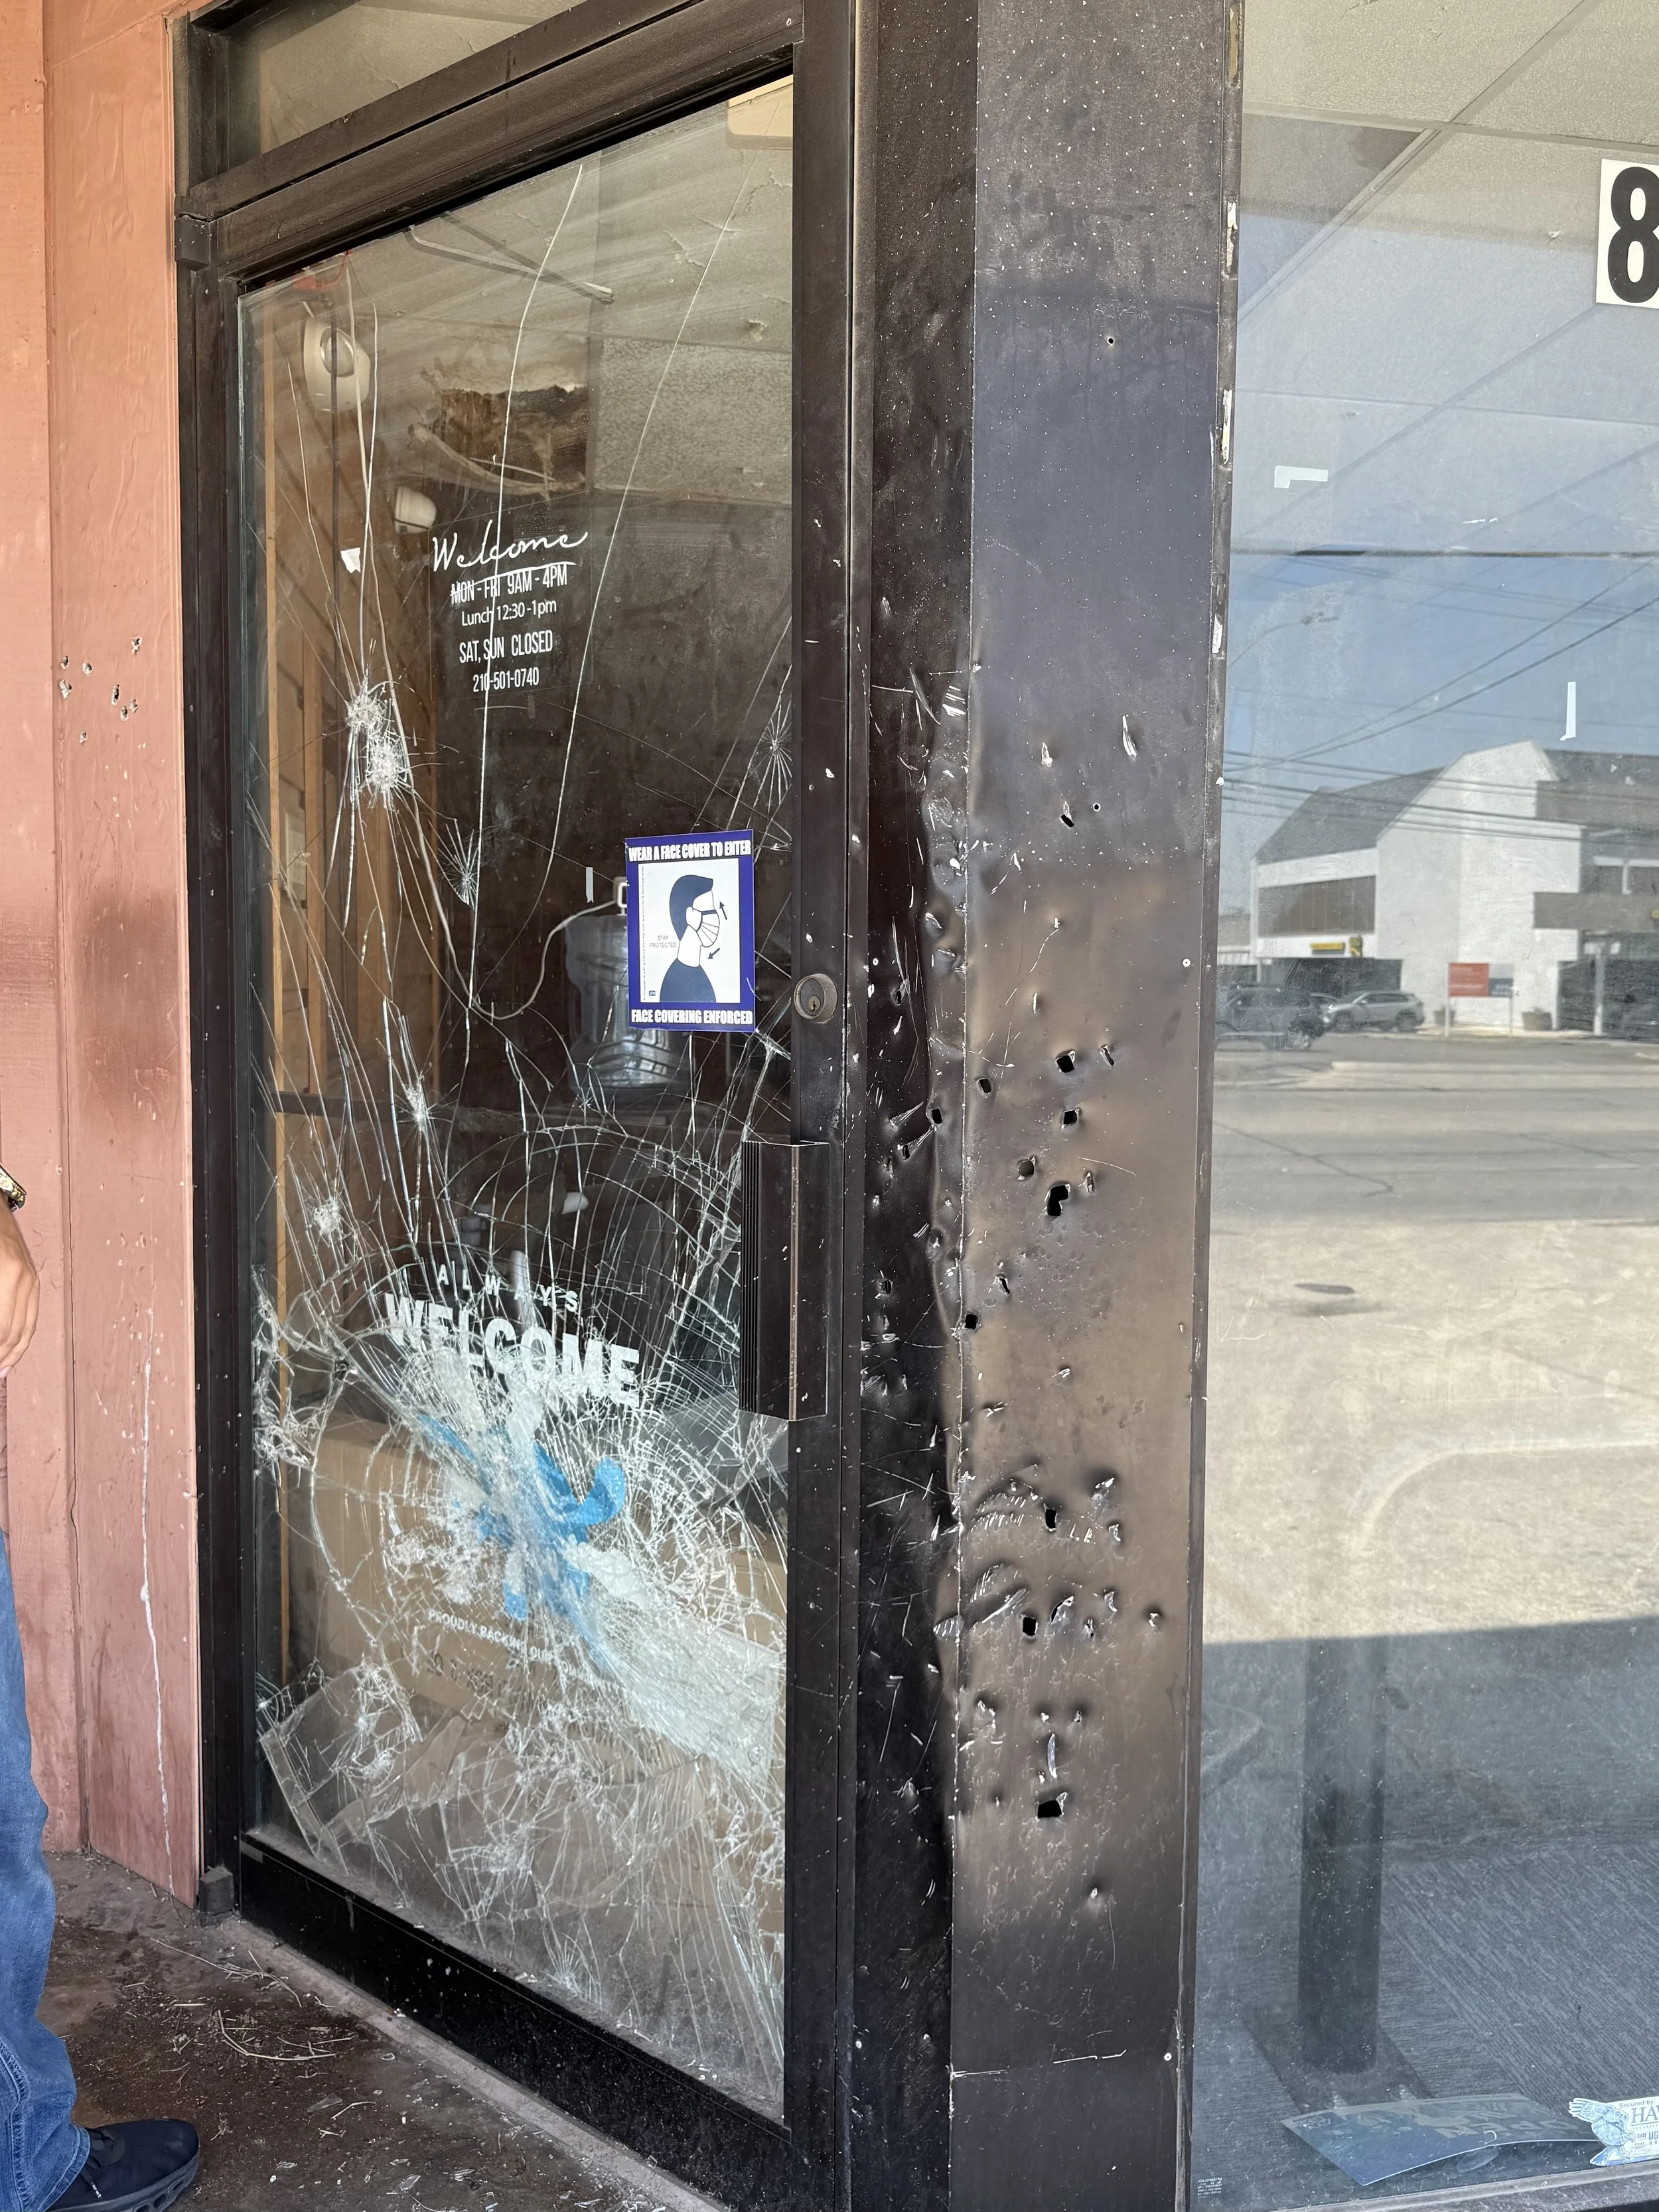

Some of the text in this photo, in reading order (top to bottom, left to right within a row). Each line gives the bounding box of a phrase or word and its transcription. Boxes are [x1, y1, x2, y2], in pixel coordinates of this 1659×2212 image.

[432, 519, 588, 572] Welcome
[451, 579, 474, 604] MON
[484, 577, 501, 599] FRI
[507, 570, 532, 595] 9AM
[542, 564, 567, 588] 4PM
[461, 606, 492, 626] Lunch
[511, 630, 553, 657] CLOSED
[472, 666, 540, 693] 210-501-0740
[628, 840, 751, 862] WEAR A FACE COVER TO ENTER
[631, 1009, 753, 1024] FACE COVERING ENFORCED
[1631, 2105, 1659, 2123] HA
